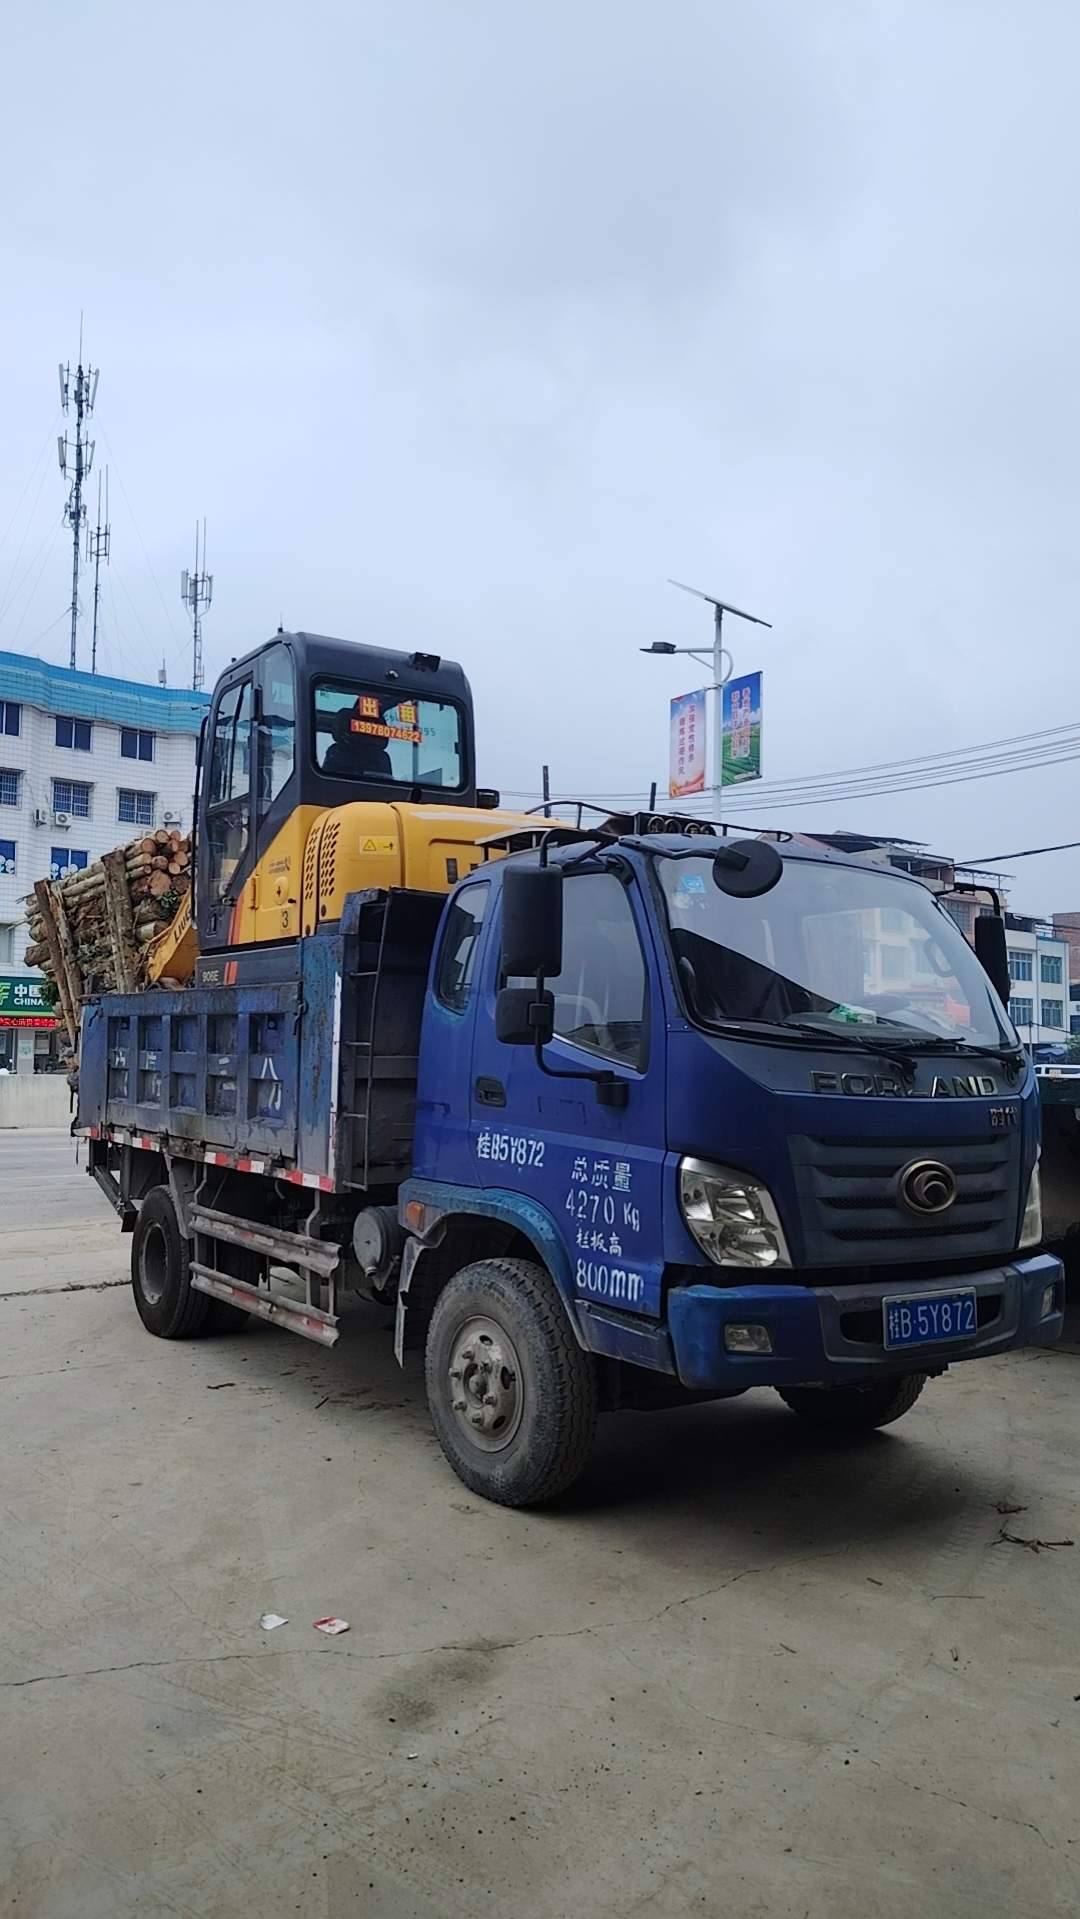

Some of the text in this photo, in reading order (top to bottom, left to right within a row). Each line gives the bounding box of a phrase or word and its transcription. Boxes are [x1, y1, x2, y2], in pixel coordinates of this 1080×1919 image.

[281, 910, 289, 928] 3
[13, 997, 44, 1006] CHINA
[14, 983, 42, 997] 中国
[477, 1131, 546, 1168] 桂B5Y872
[571, 1156, 632, 1193] 总质量
[565, 1188, 616, 1225] 4270
[576, 1258, 644, 1301] 800mm
